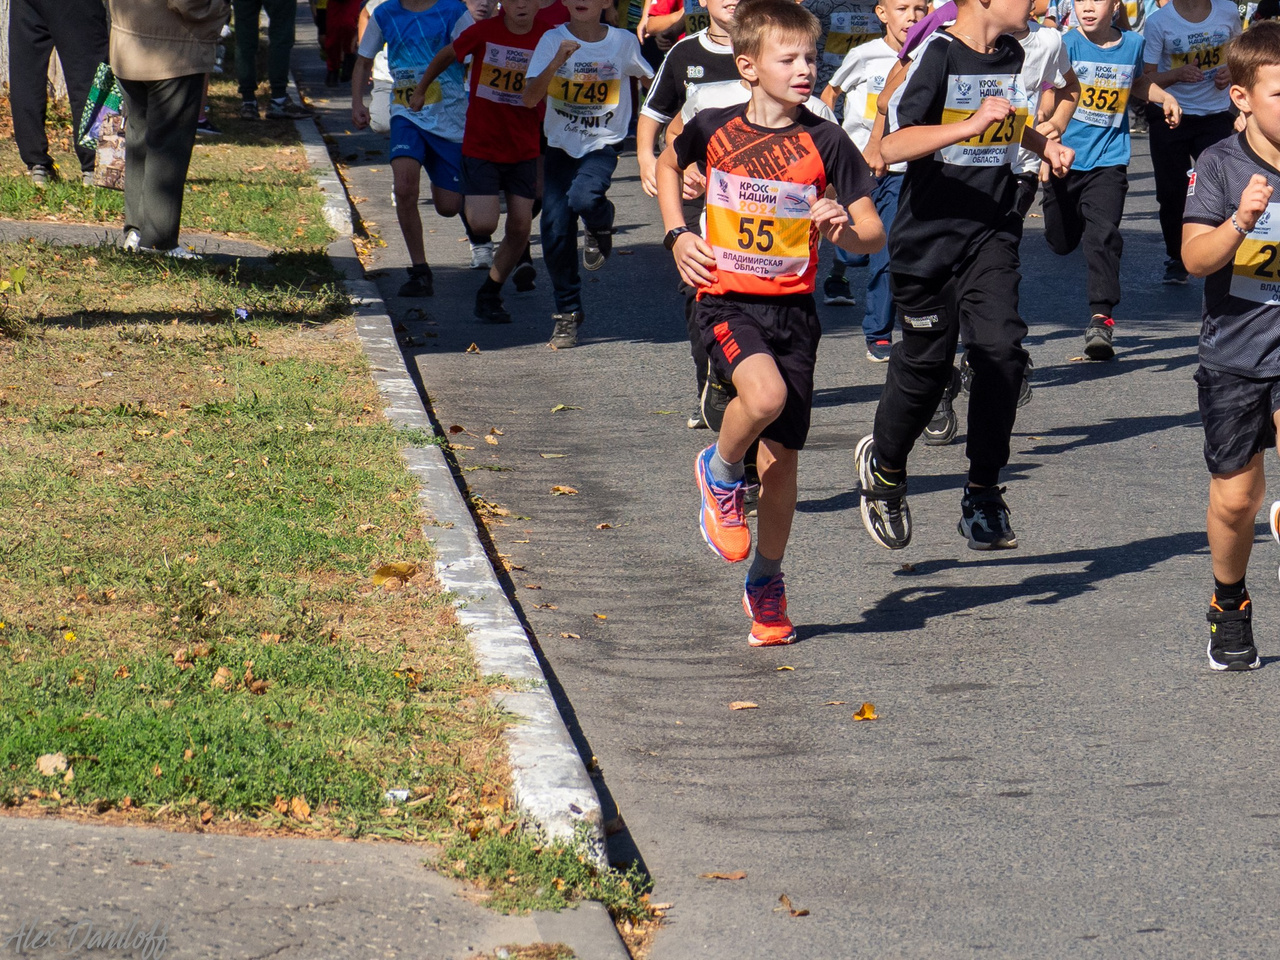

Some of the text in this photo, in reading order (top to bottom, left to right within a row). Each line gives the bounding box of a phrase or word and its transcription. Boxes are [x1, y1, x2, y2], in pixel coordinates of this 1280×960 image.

[506, 55, 528, 63] НАЦИИ
[489, 68, 524, 92] 218
[1094, 71, 1117, 80] НАЦИИ
[979, 79, 998, 88] КРОСС
[561, 81, 608, 104] 1749
[979, 88, 1004, 97] НАЦИИ
[1082, 87, 1119, 111] 352
[1084, 115, 1108, 125] ОБЛАСТЬ
[972, 155, 1000, 164] ОБЛАСТЬ
[739, 181, 769, 193] КРОСС
[738, 191, 777, 204] НАЦИИ
[738, 201, 777, 215] 2024
[737, 217, 774, 252] 55
[722, 251, 783, 267] ВЛАДИМИРСКАЯ
[734, 262, 770, 275] ОБЛАСТЬ
